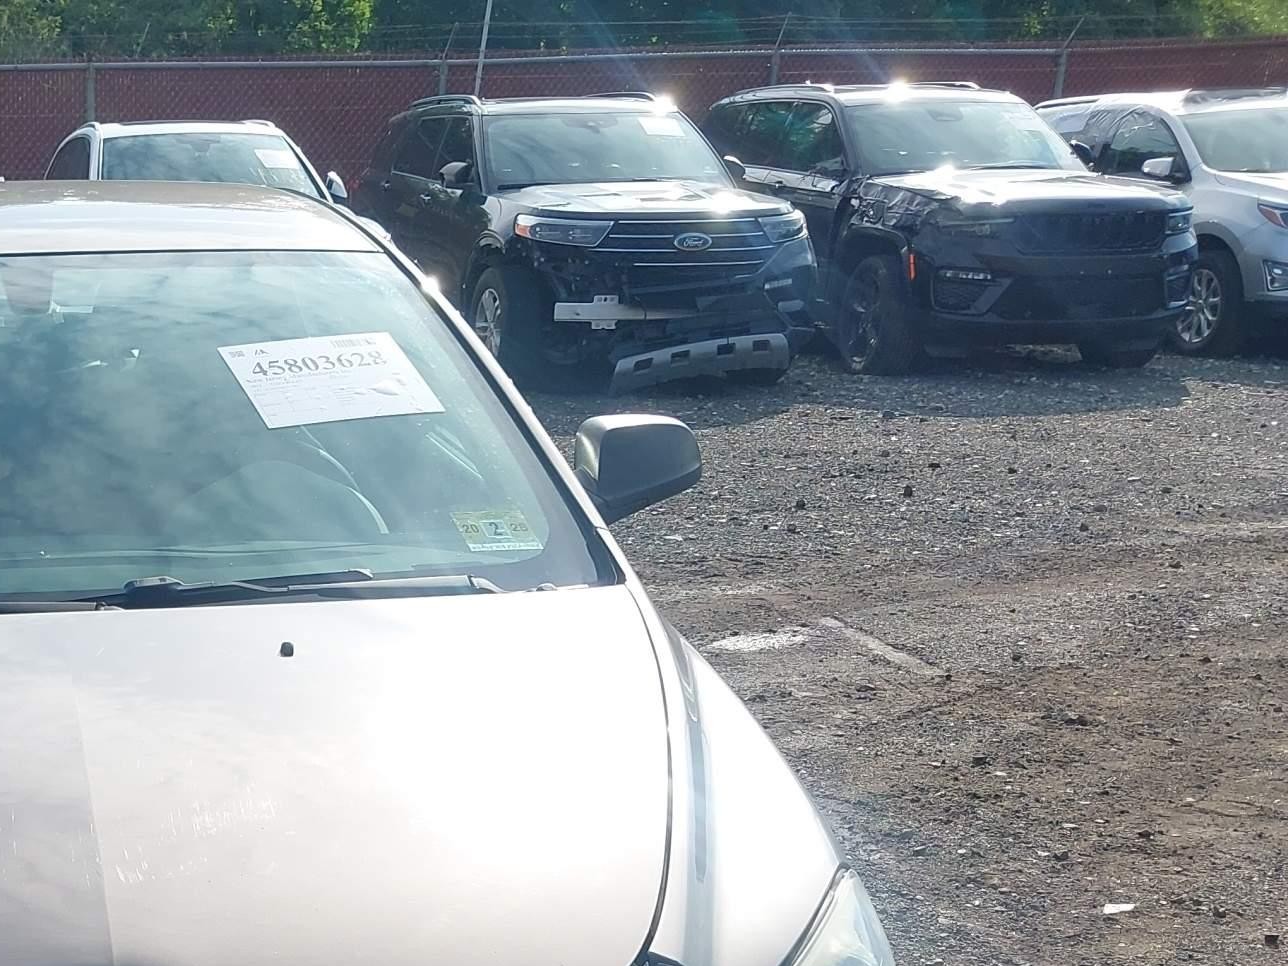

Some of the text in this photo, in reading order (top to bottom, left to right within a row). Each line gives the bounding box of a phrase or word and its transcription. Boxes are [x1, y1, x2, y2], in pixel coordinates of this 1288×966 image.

[251, 351, 388, 377] 45803628
[461, 523, 480, 534] 20
[488, 521, 504, 536] 2
